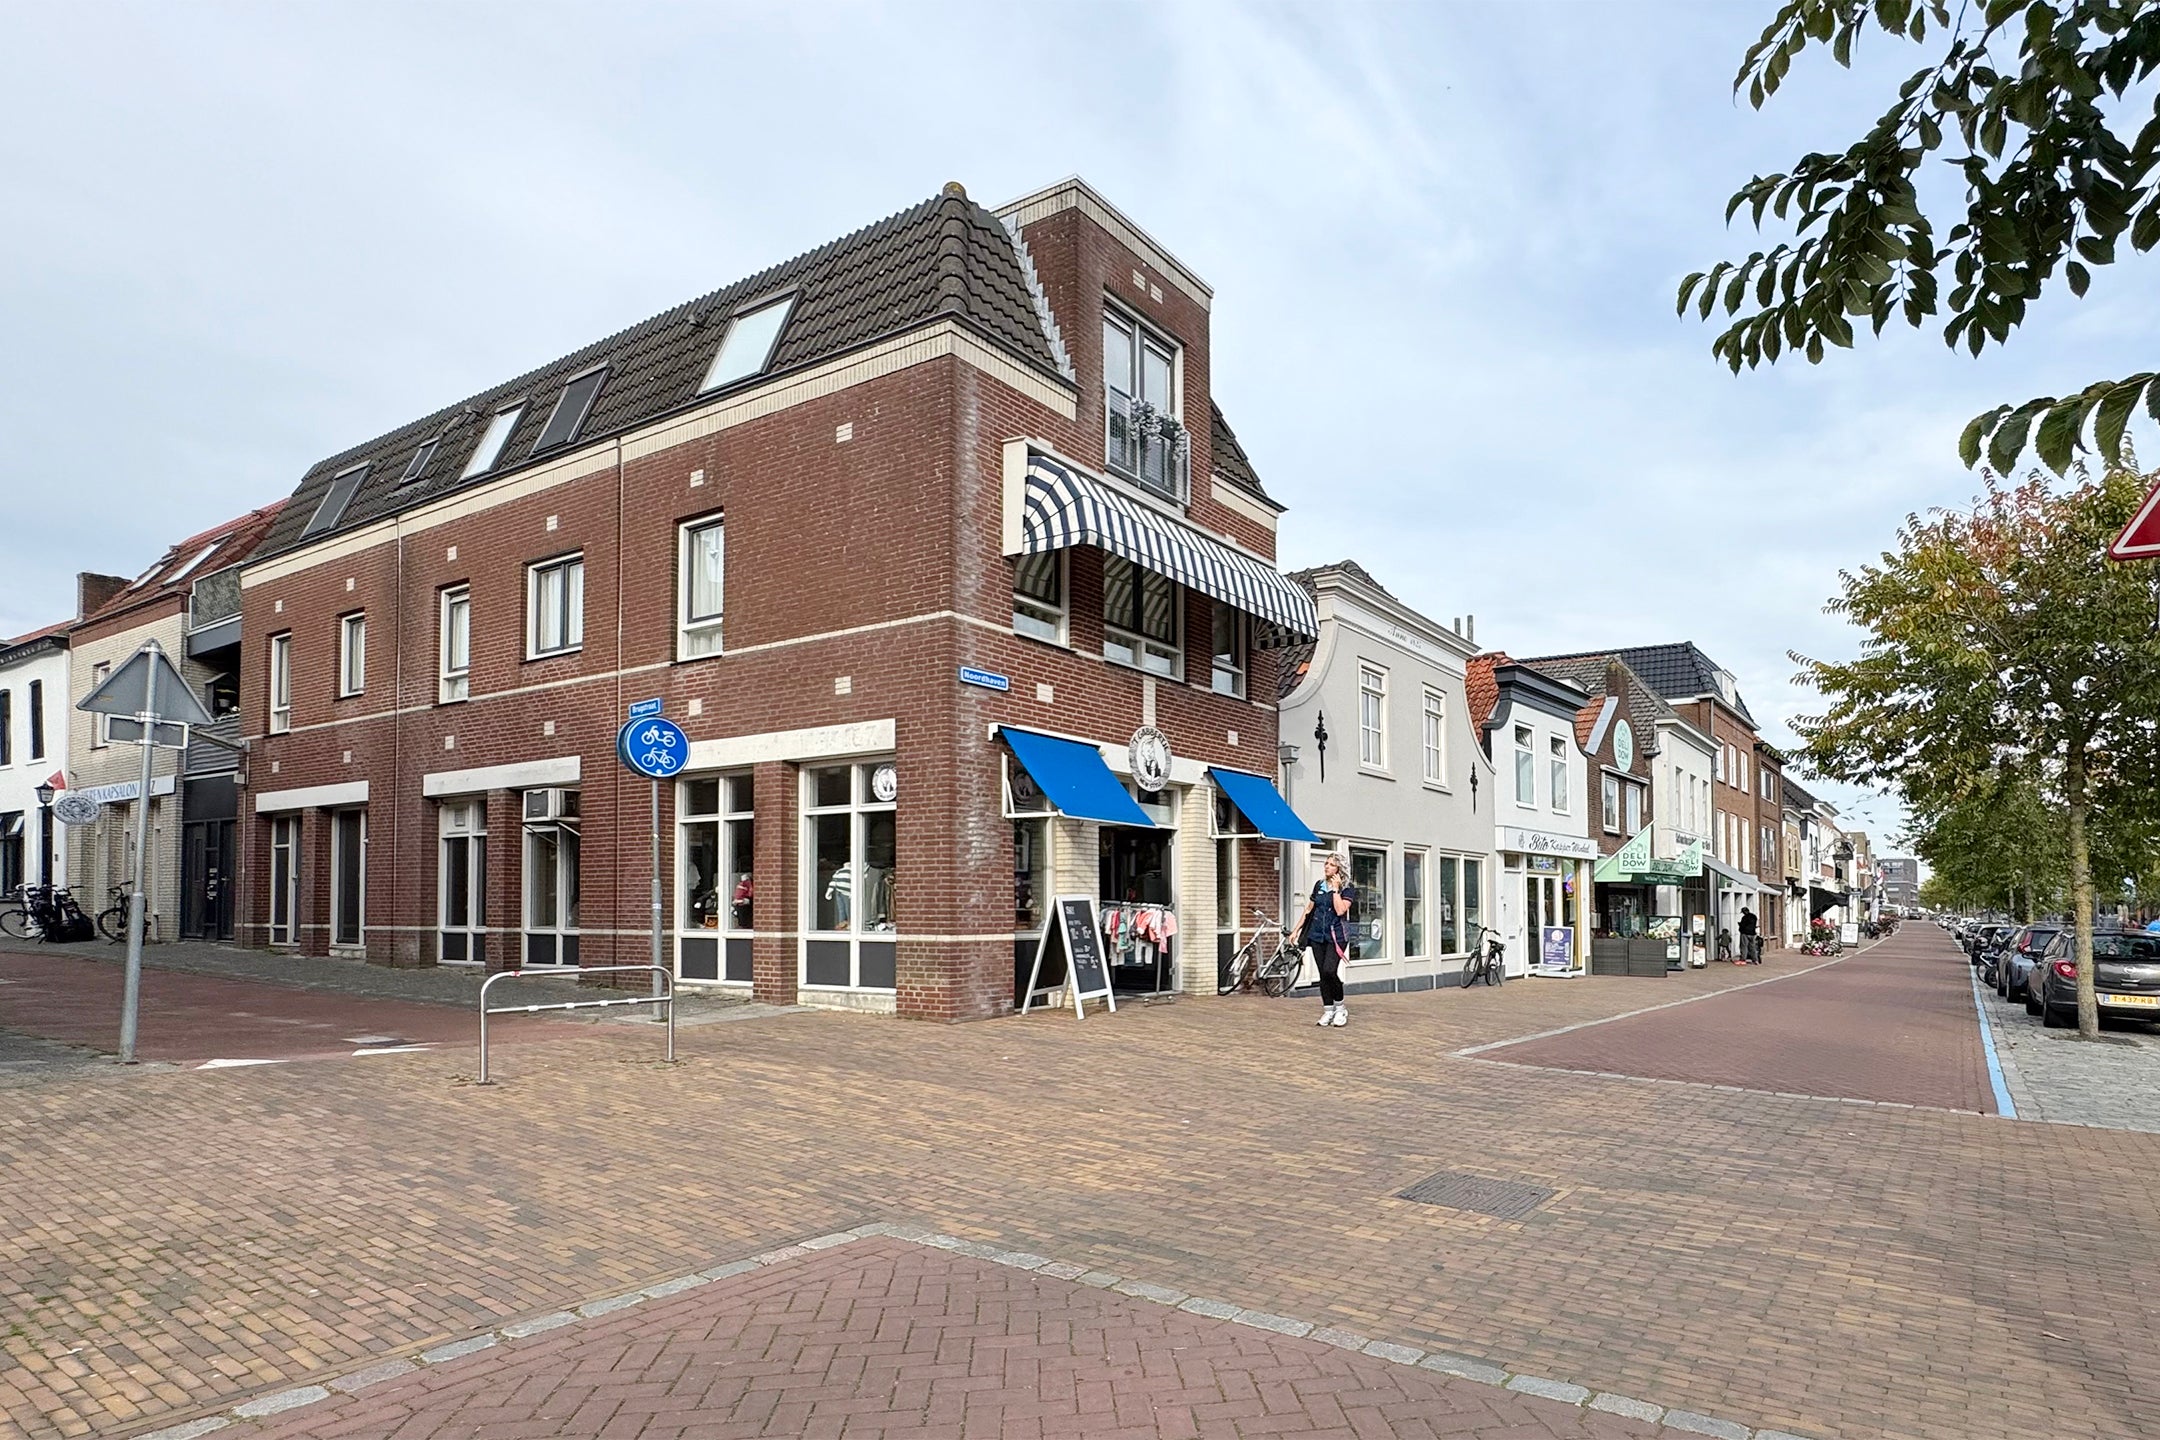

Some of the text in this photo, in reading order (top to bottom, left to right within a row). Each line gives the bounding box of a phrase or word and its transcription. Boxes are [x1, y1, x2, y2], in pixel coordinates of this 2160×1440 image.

[964, 671, 1006, 687] Noordhaven
[632, 702, 657, 714] Brugstraat
[1529, 833, 1549, 851] Bito
[1622, 852, 1647, 860] DELI
[1622, 859, 1647, 867] DOW
